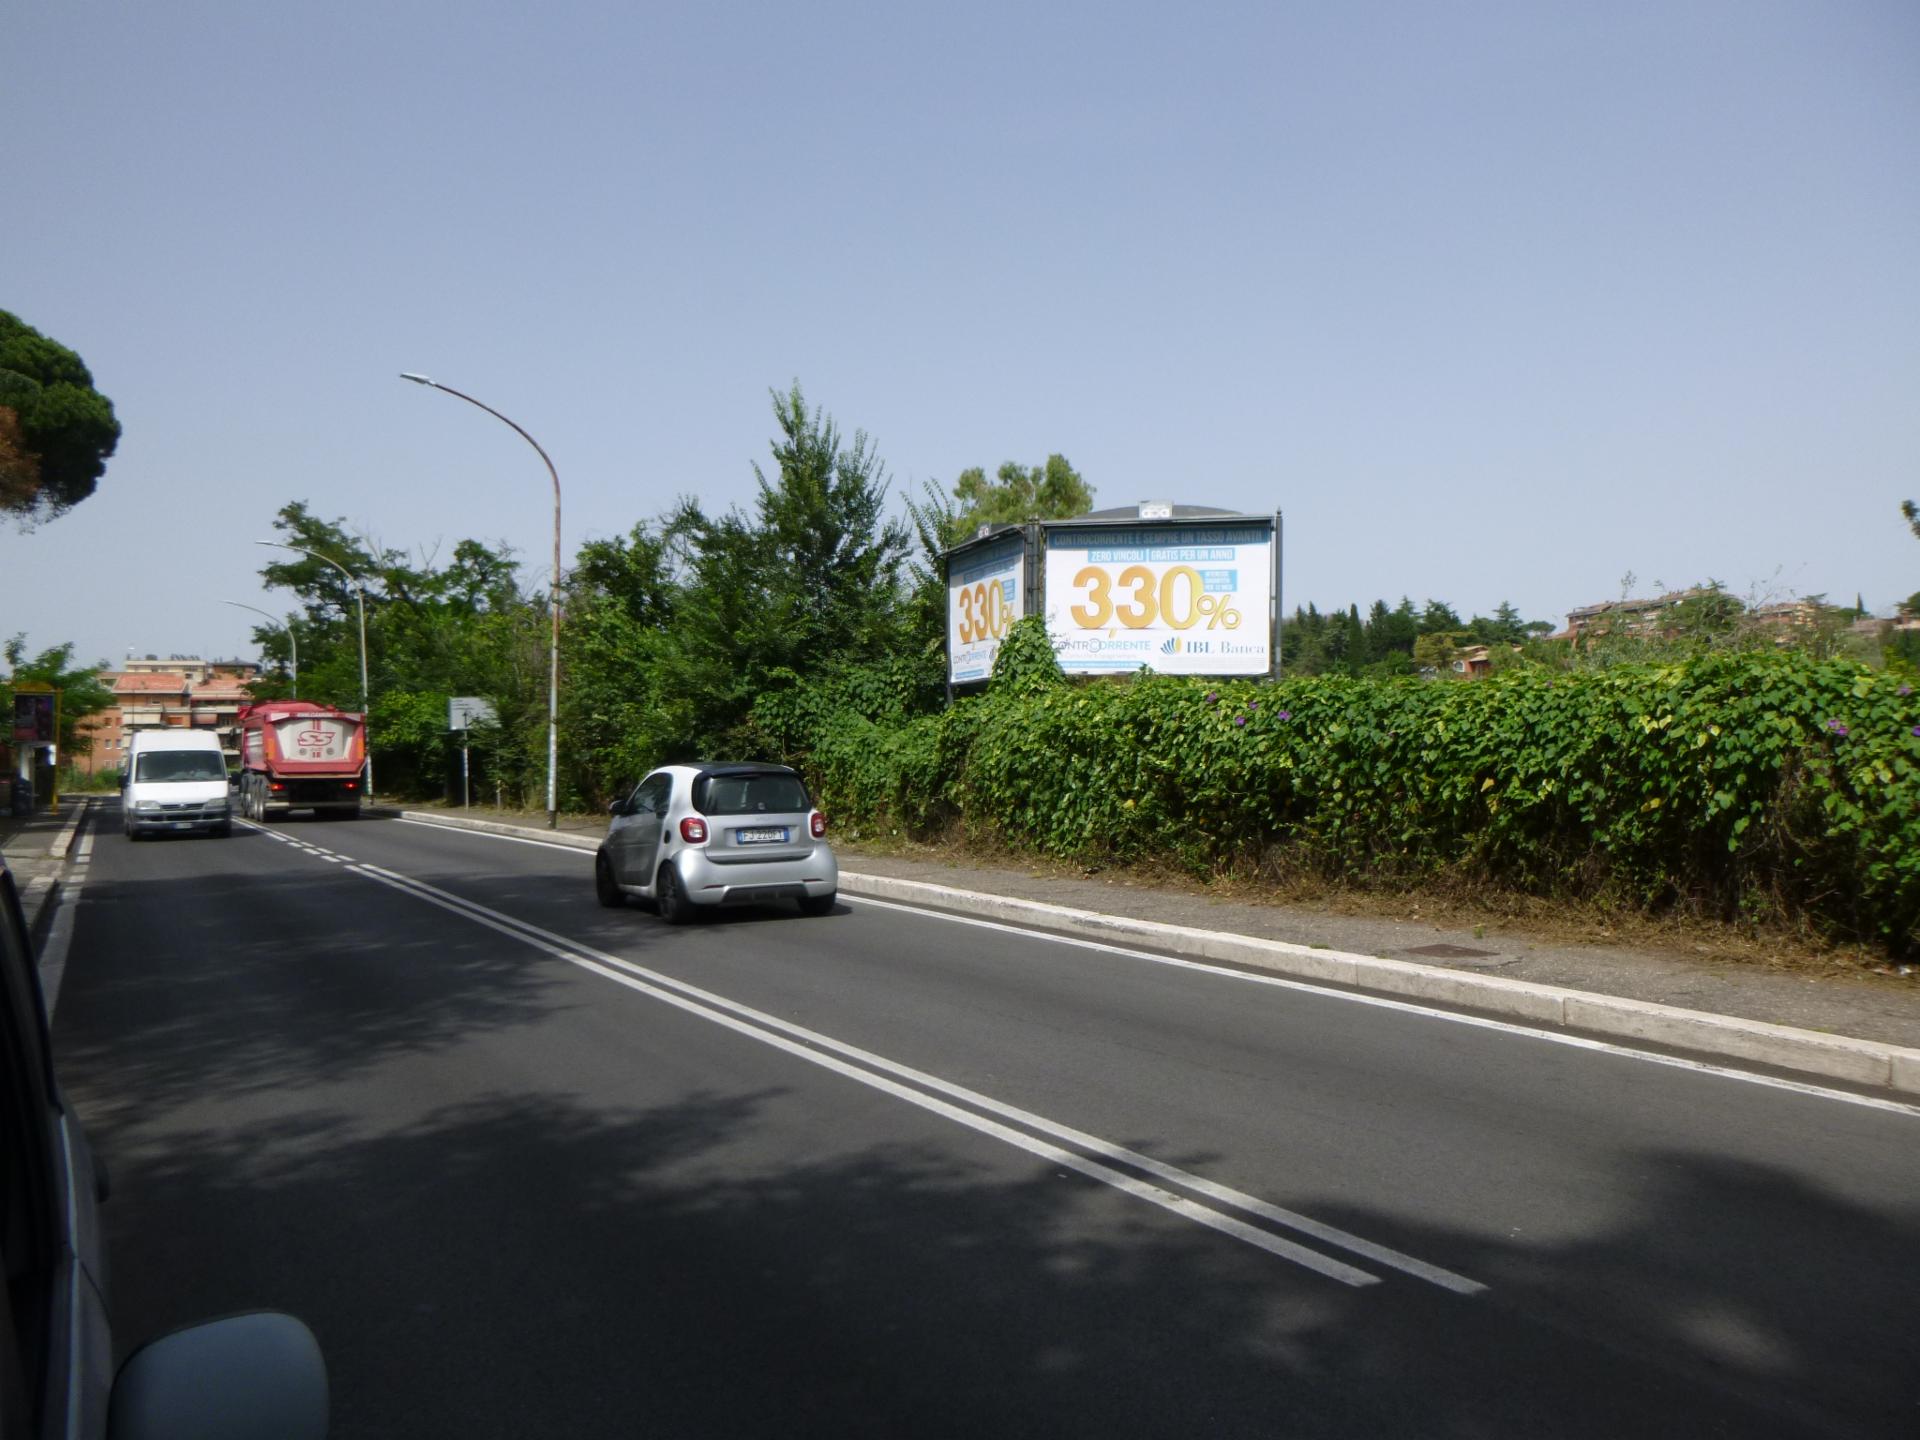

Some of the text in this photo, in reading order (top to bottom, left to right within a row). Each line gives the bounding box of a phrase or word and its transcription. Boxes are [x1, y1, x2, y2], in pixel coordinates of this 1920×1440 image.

[1091, 550, 1144, 562] ZERO VINCOLI
[1151, 549, 1178, 561] GRATIS
[1180, 549, 1195, 560] PER
[1187, 641, 1265, 653] IBL Banca
